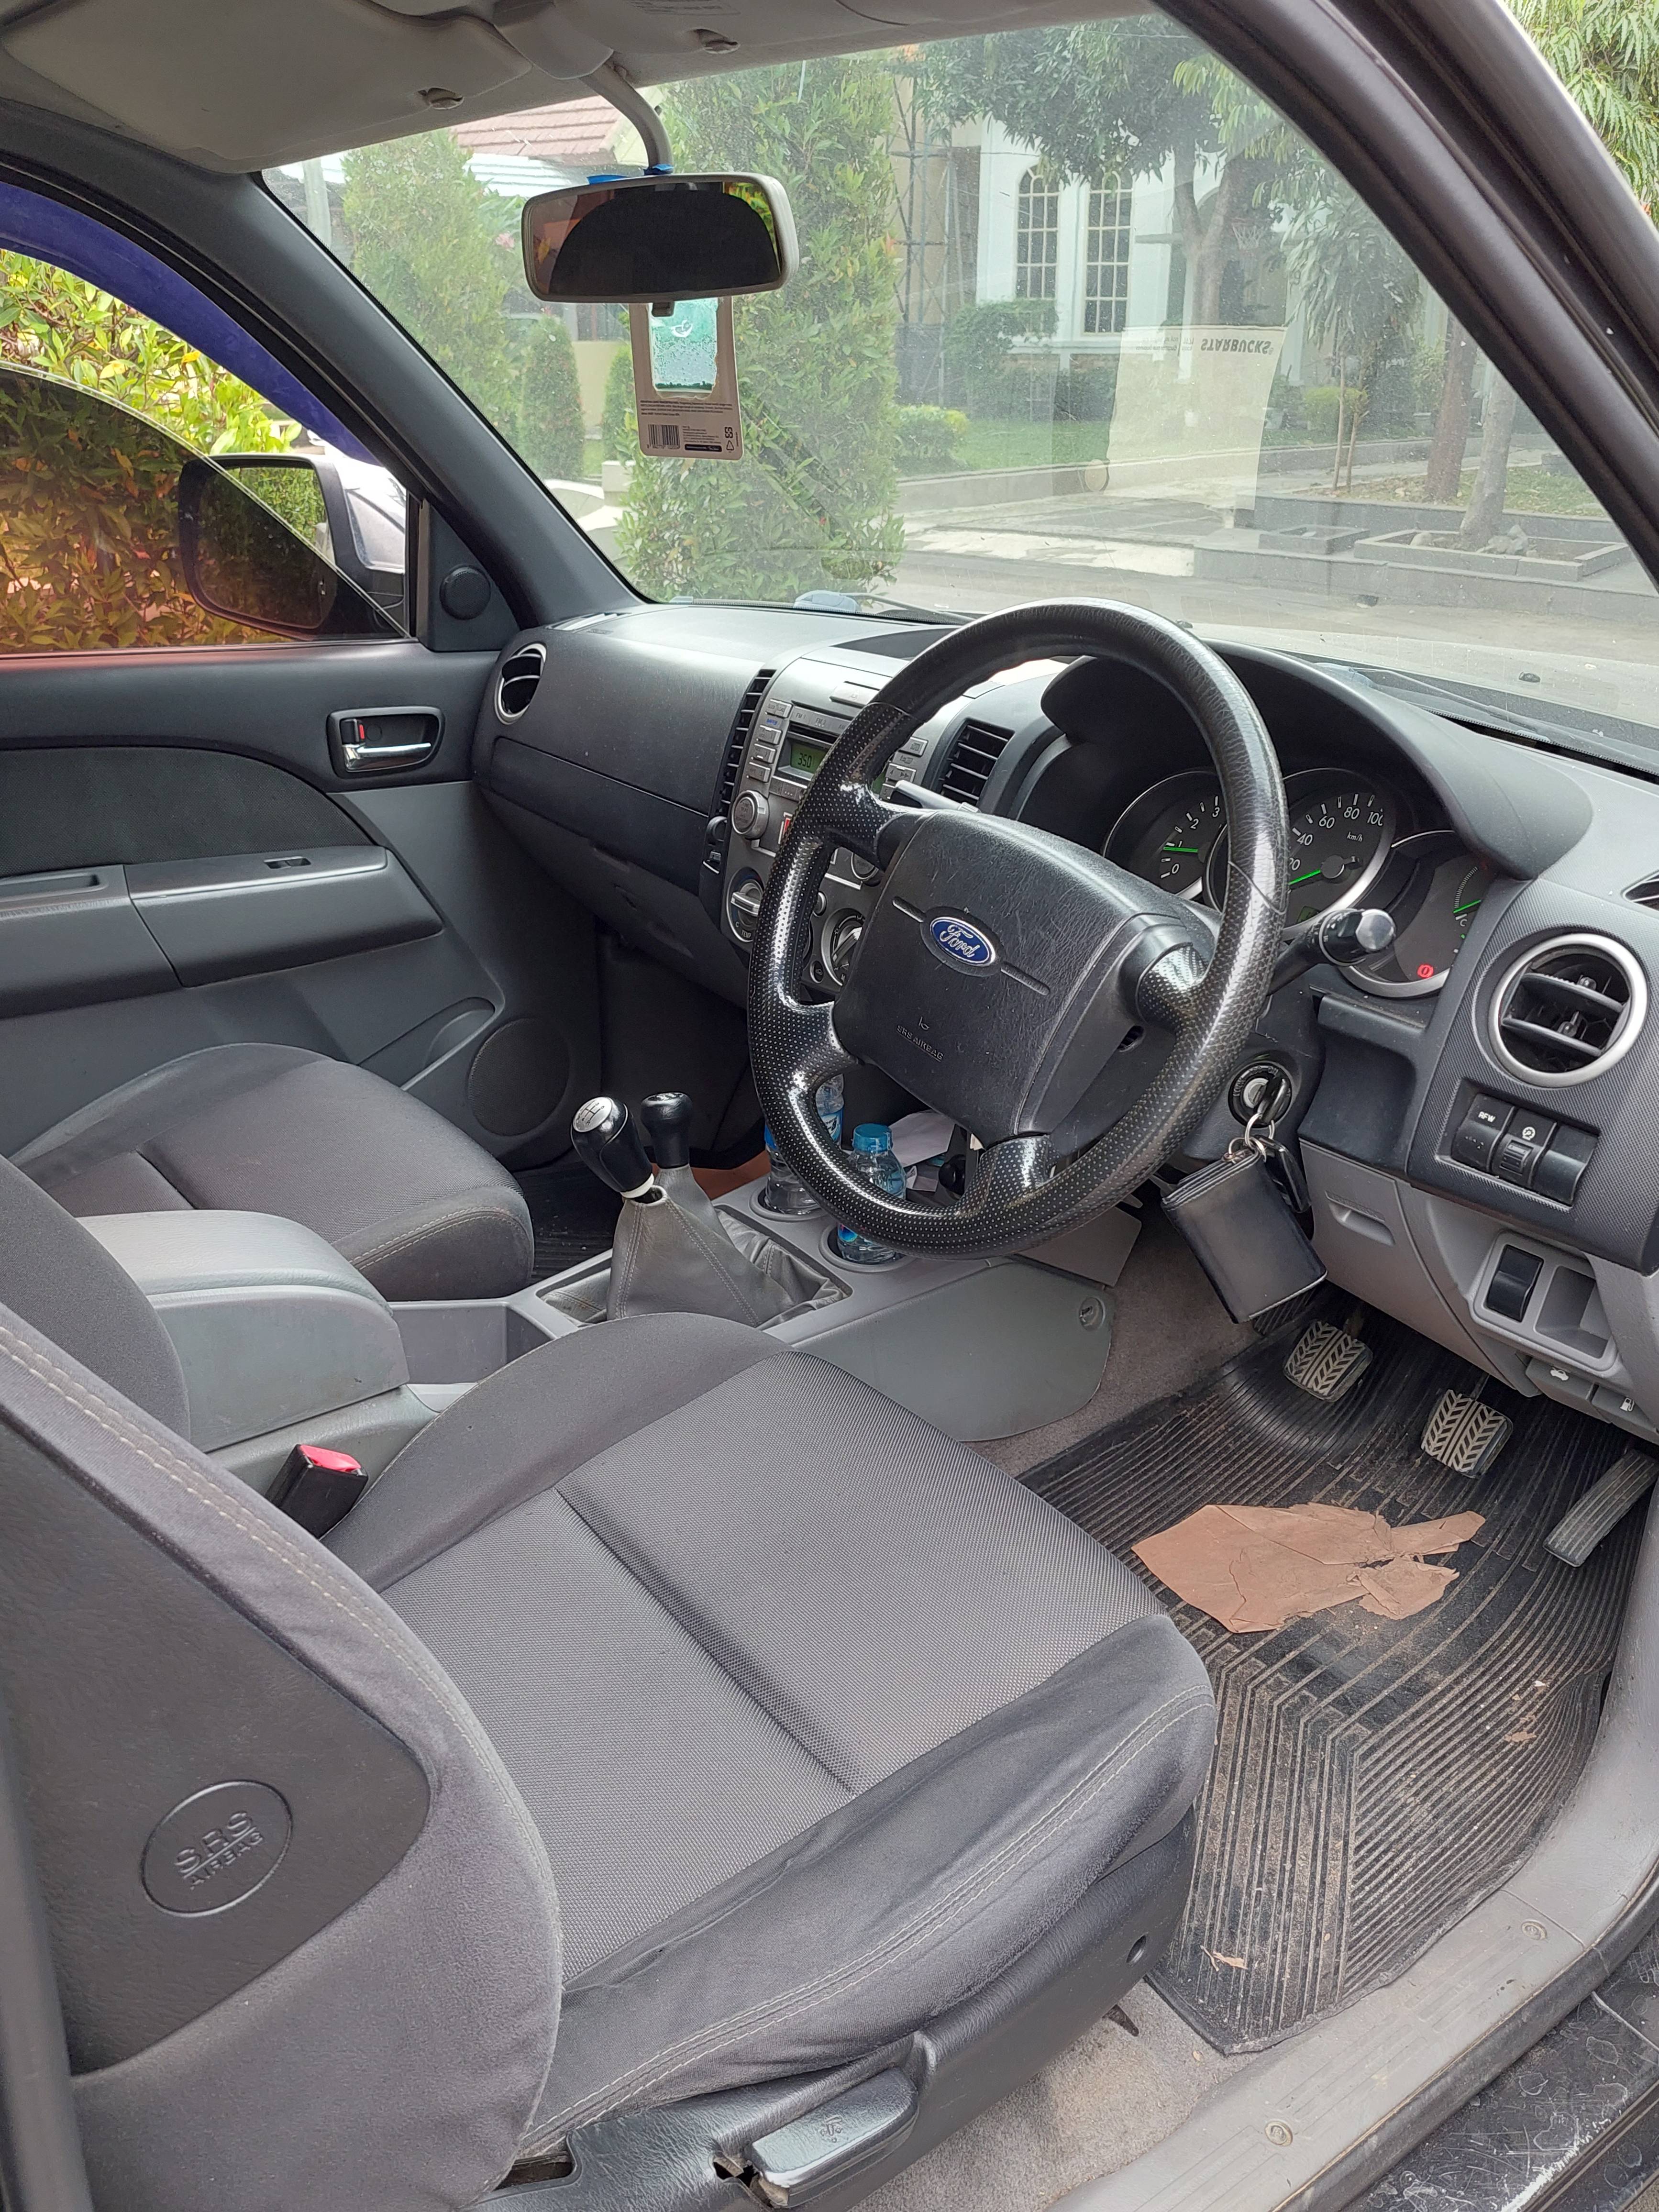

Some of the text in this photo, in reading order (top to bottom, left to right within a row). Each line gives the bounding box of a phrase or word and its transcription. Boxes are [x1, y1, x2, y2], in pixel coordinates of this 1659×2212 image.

[1212, 807, 1220, 818] 3
[1344, 807, 1360, 819] 80
[1190, 818, 1199, 830] 2
[1319, 816, 1335, 829] 60
[1296, 833, 1313, 845] 40
[1347, 831, 1363, 842] km/h
[1172, 863, 1180, 874] 0
[1460, 919, 1468, 927] C
[940, 924, 980, 958] Ford
[1478, 1111, 1496, 1123] RFW
